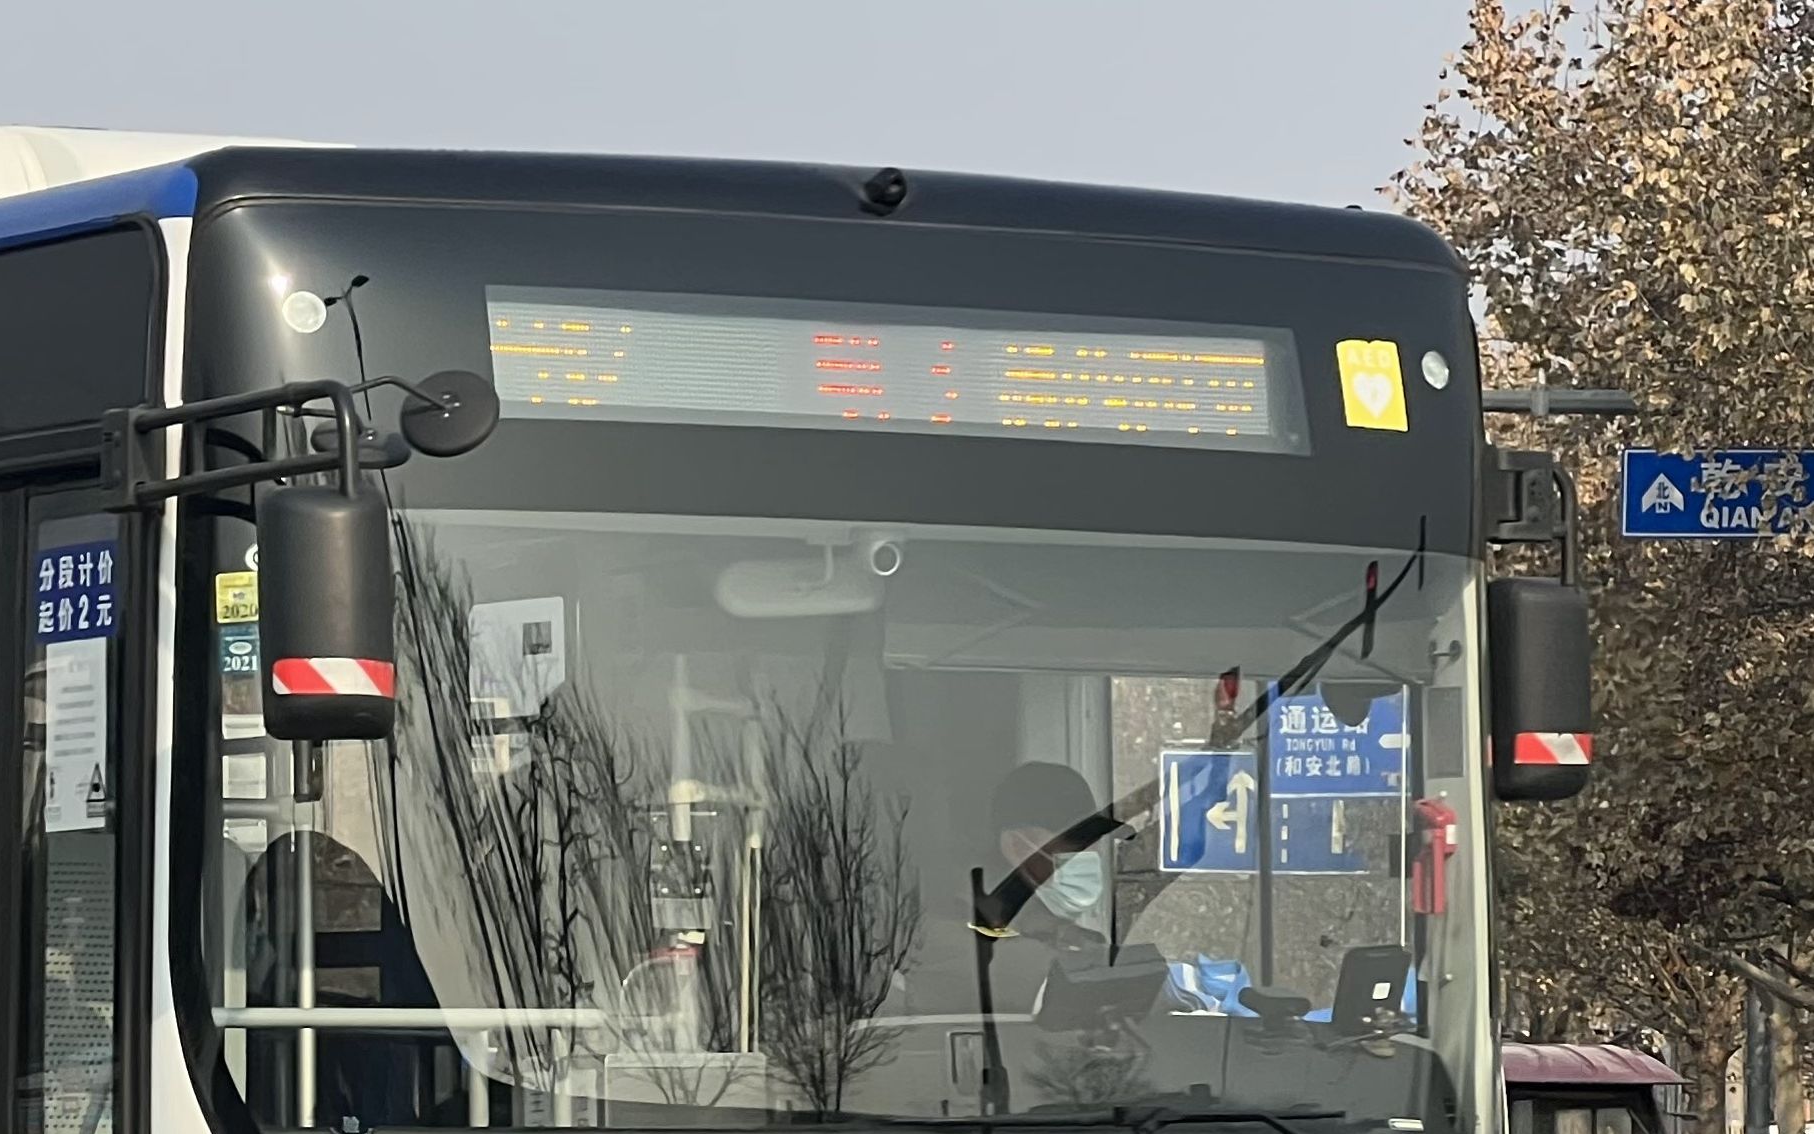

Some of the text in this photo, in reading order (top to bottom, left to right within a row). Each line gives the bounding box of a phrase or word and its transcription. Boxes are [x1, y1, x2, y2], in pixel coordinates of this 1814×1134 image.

[38, 549, 114, 592] 分段计价
[37, 594, 112, 634] 起价2元
[222, 604, 258, 619] 2020
[223, 655, 258, 672] 2021
